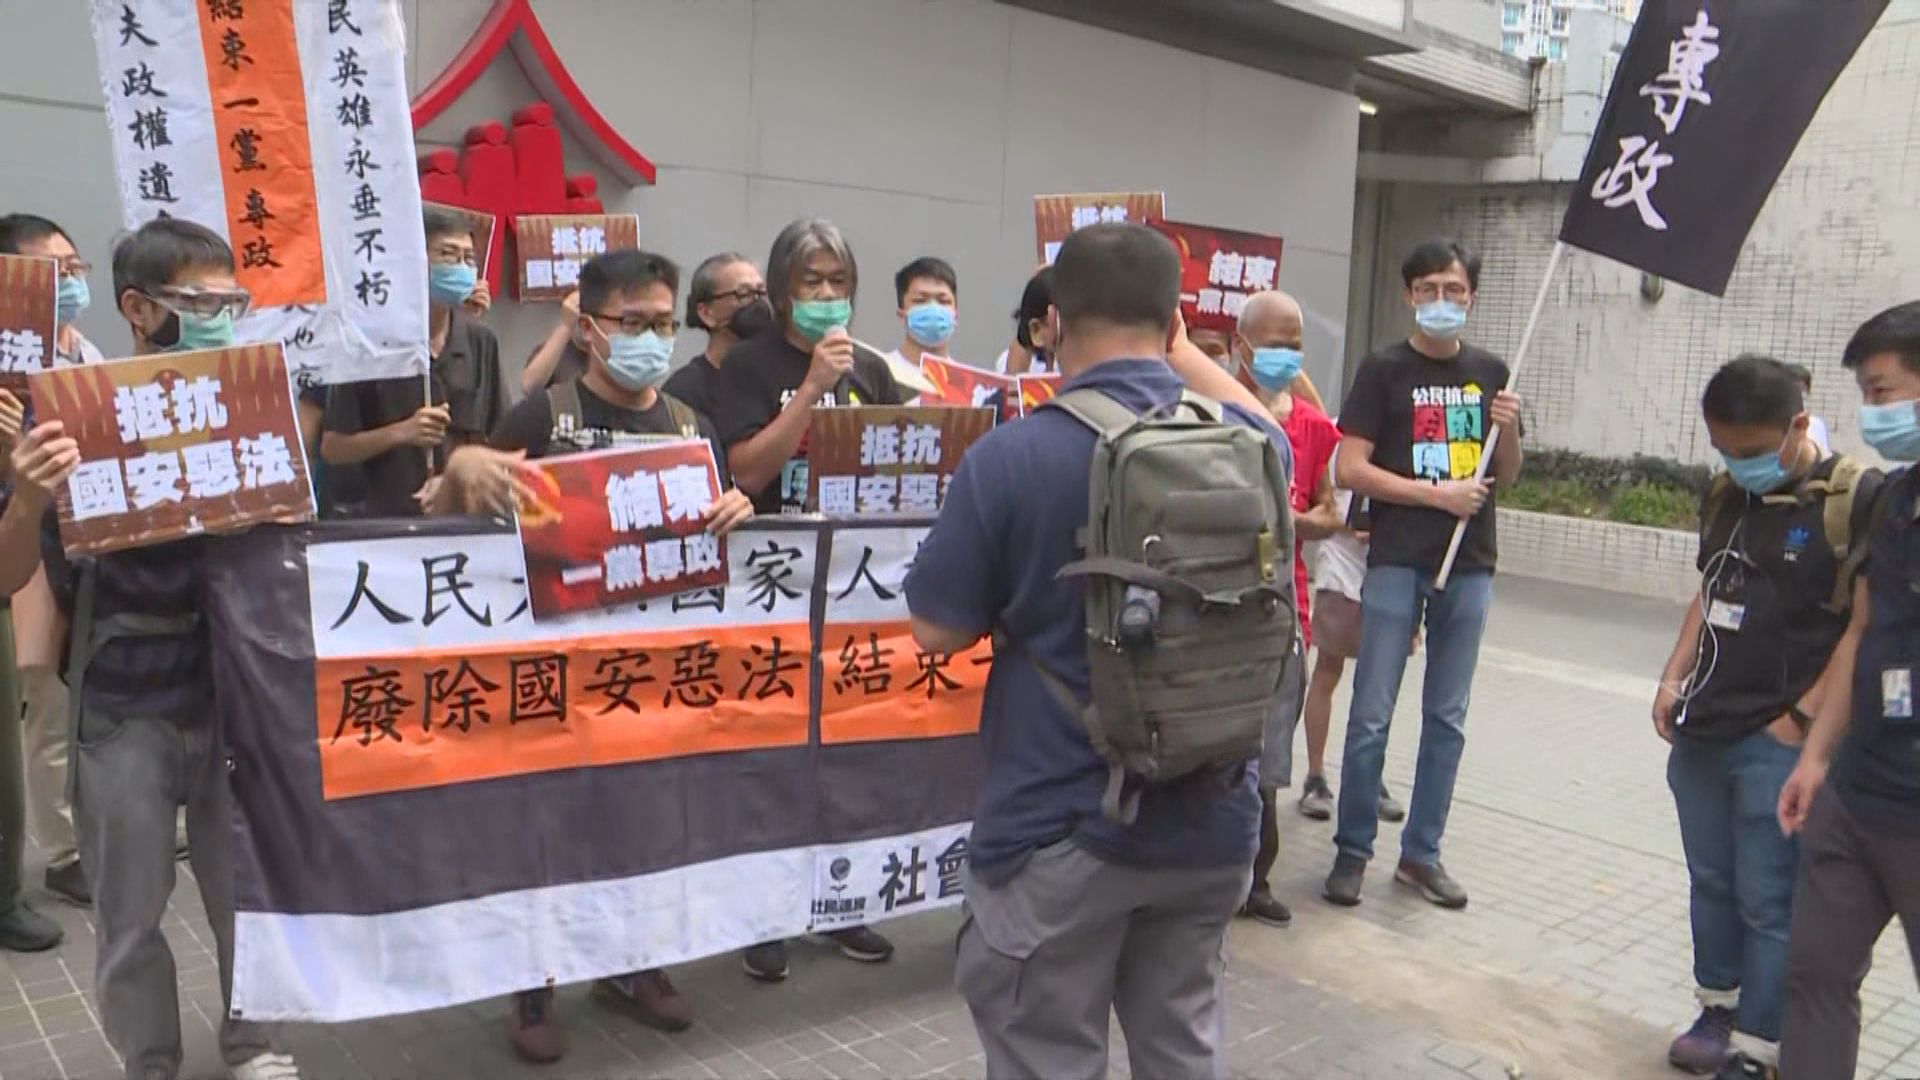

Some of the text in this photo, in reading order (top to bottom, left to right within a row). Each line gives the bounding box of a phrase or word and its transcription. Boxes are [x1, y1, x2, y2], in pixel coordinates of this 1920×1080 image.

[119, 4, 180, 220] 夫政權遺
[1591, 9, 1720, 230] 專政
[551, 226, 607, 256] 抵抗
[1207, 249, 1277, 291] 結束
[113, 374, 229, 444] 抵抗
[68, 431, 297, 522] 國安惡法
[860, 423, 942, 467] 抵抗
[604, 463, 715, 533] 結束
[818, 472, 953, 514] 國安惡
[561, 532, 722, 593] 一黨專政
[330, 636, 805, 746] 廢除國安惡法
